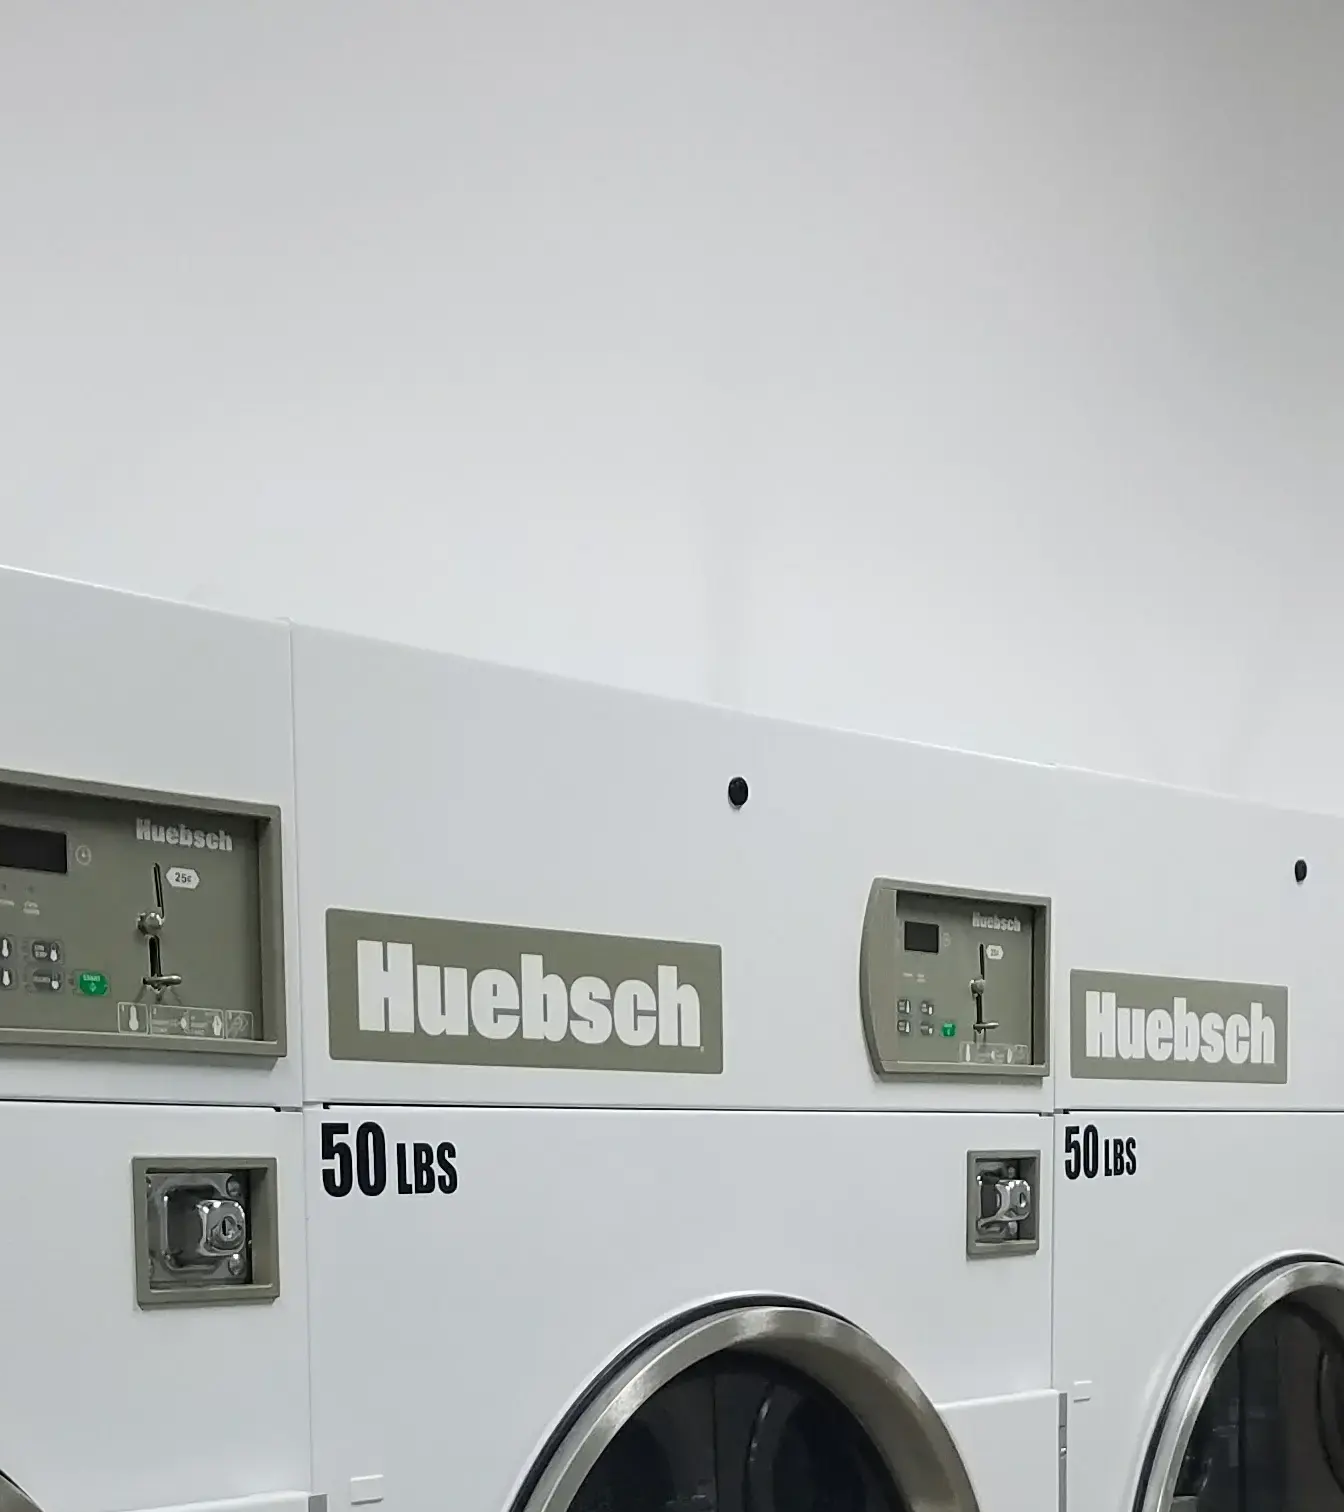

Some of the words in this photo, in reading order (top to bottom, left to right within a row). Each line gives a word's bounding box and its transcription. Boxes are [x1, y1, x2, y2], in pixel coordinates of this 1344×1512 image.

[136, 817, 233, 851] Huebsch
[356, 939, 703, 1048] Huebsch
[1085, 990, 1276, 1065] Huebsch
[321, 1121, 387, 1198] 50
[396, 1141, 458, 1195] LBS
[1064, 1123, 1099, 1181] 50
[1104, 1136, 1137, 1177] LBS
